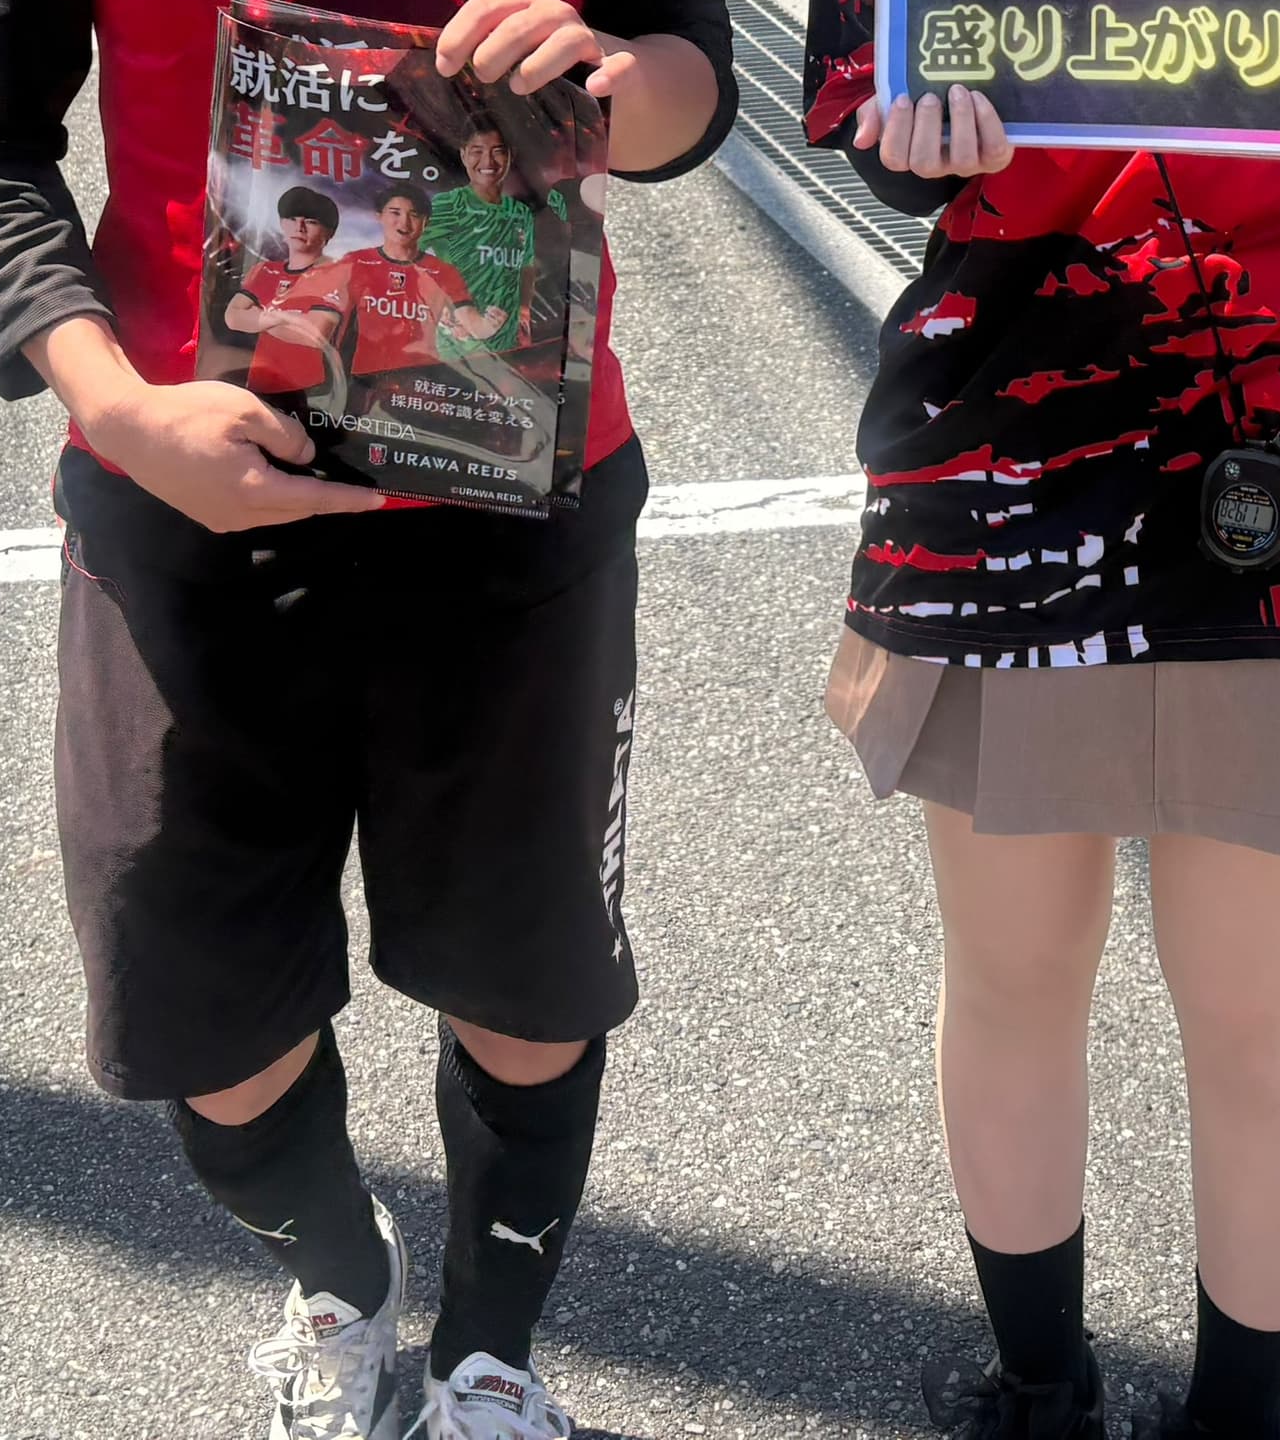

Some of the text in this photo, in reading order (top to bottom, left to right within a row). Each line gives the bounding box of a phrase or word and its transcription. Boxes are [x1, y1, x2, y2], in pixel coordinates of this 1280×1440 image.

[230, 43, 389, 112] 就活に
[229, 101, 440, 183] 革命を。
[363, 295, 430, 322] POLUS
[390, 393, 534, 429] 採用の常識を変える
[413, 379, 535, 411] 就活フットサルで
[393, 450, 518, 481] URAWA REDS
[496, 492, 524, 504] REDS
